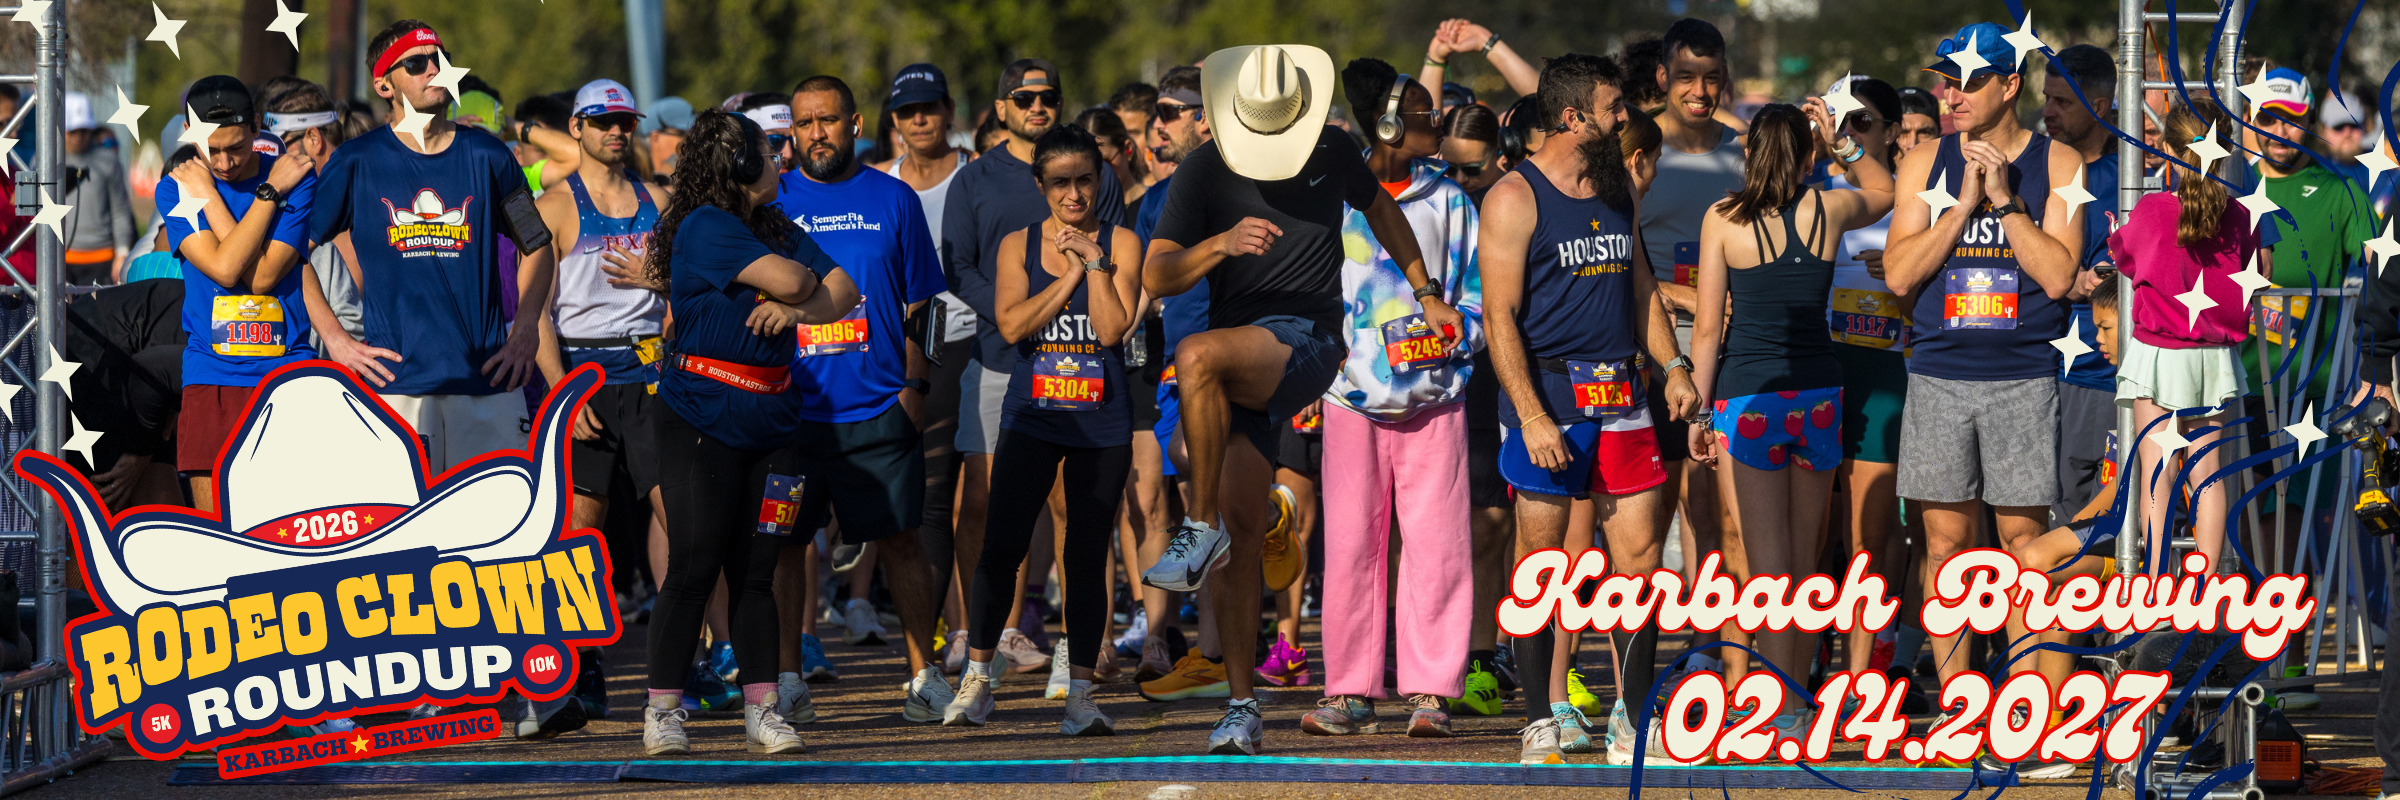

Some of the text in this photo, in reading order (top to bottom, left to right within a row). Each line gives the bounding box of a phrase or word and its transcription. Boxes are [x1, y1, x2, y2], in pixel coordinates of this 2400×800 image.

[811, 221, 881, 233] America's Fund
[812, 212, 864, 224] Semper Fi &
[389, 224, 470, 244] RODEO CLOWN
[1558, 233, 1634, 268] HOUSTON
[1955, 247, 2000, 258] RUNNING
[1956, 295, 2003, 316] 5306
[226, 322, 272, 344] 1198
[810, 321, 855, 344] 5096
[1845, 314, 1889, 337] 1117
[1041, 343, 1083, 353] RUNNING
[1399, 336, 1443, 362] 5245
[708, 366, 740, 384] HOUSTON
[744, 379, 772, 392] ASTROS
[1044, 377, 1089, 399] 5304
[1586, 384, 1624, 405] 5125
